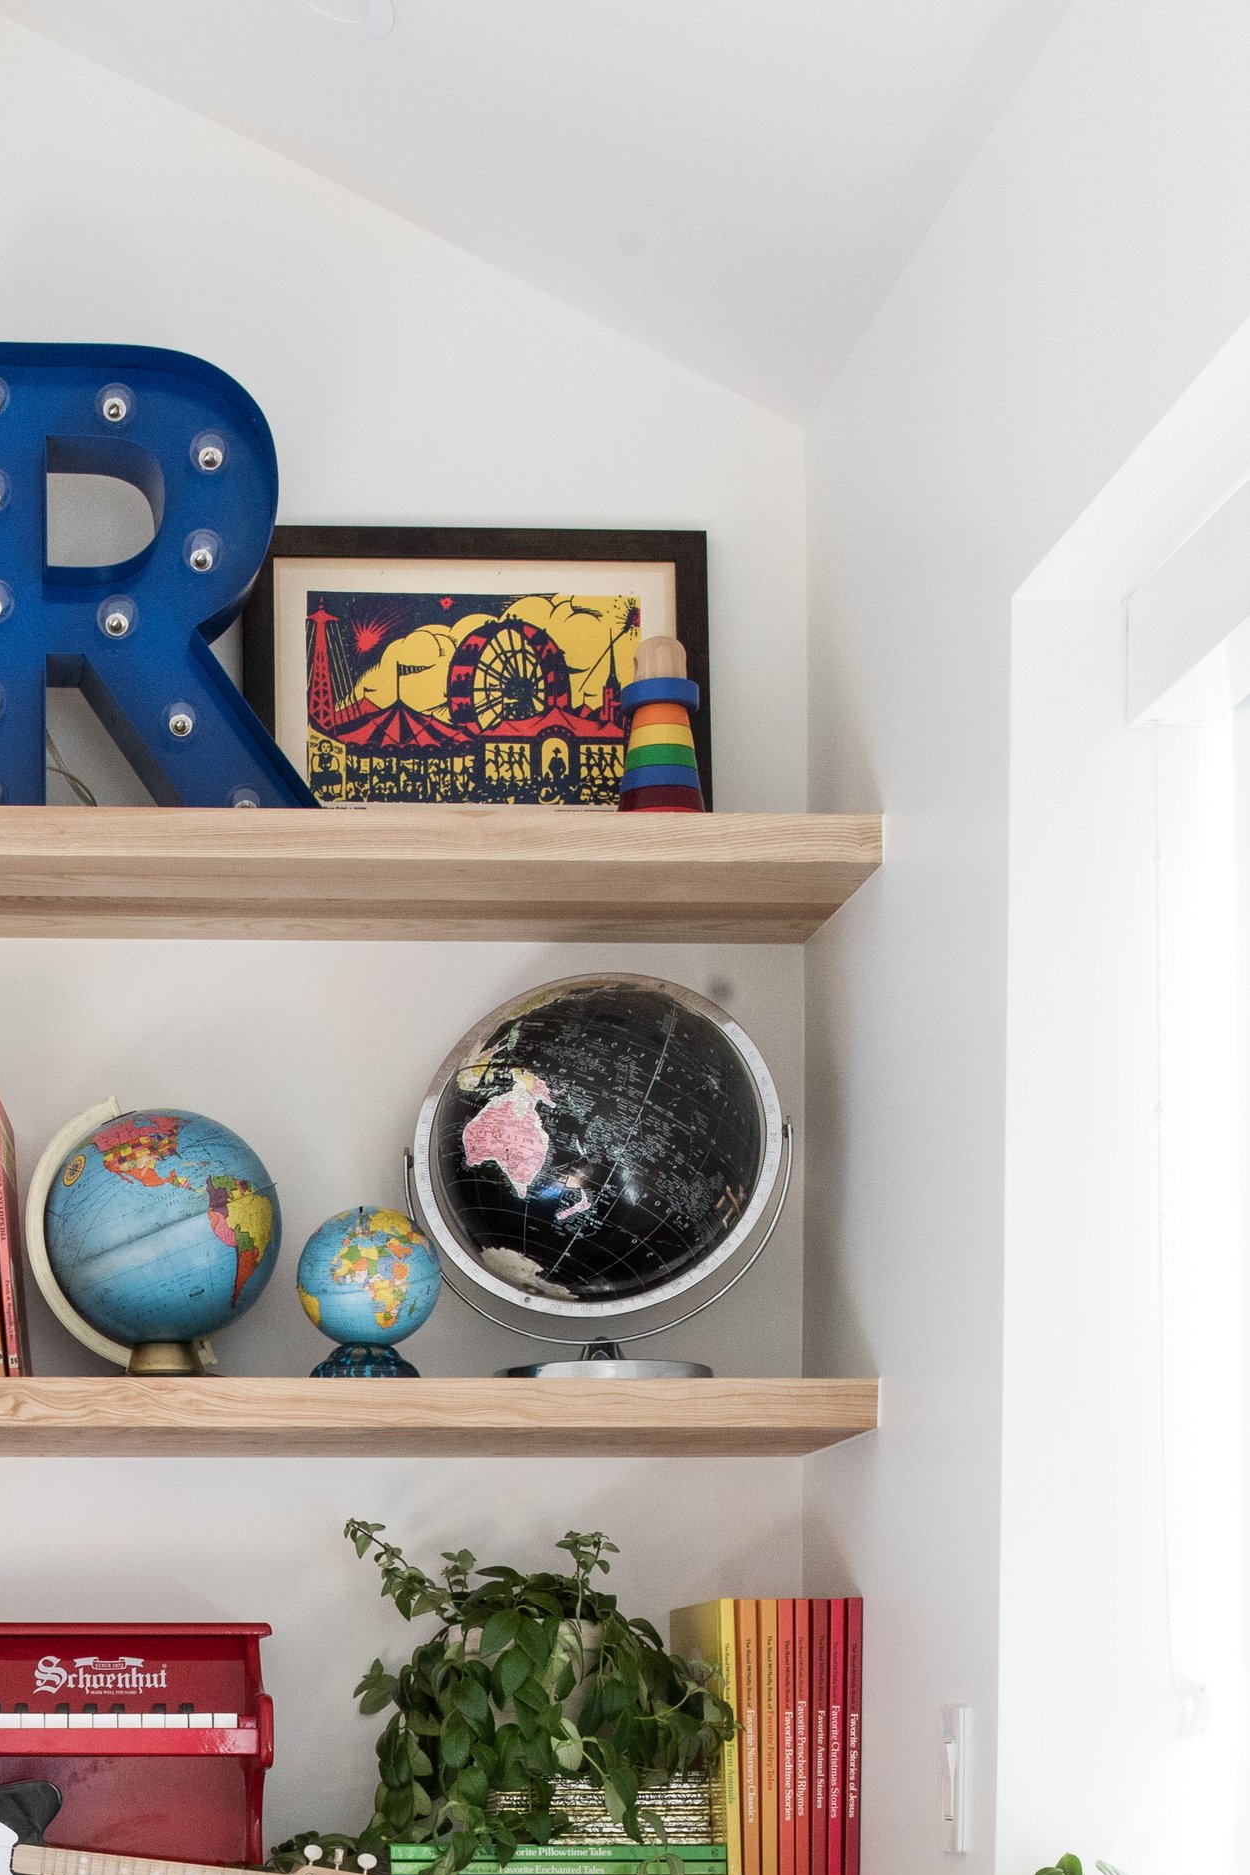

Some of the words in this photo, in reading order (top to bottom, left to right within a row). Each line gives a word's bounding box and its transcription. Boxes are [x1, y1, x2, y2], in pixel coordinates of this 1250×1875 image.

[33, 1656, 167, 1694] Schoenhut
[785, 1712, 793, 1746] Favorite
[798, 1701, 806, 1736] Favorite
[831, 1706, 840, 1741] Favorite
[850, 1714, 858, 1748] Favorite
[726, 1744, 734, 1767] Farm
[746, 1748, 755, 1784] Nursery
[766, 1747, 774, 1768] Fairy
[785, 1749, 793, 1788] Bedtime
[798, 1737, 806, 1779] Preschool
[831, 1742, 839, 1786] Christmas
[849, 1750, 858, 1780] Stories
[727, 1769, 735, 1804] Animals
[796, 1781, 806, 1816] Rhymes
[831, 1787, 839, 1818] Stories
[849, 1782, 857, 1792] of
[748, 1786, 756, 1823] Classics
[785, 1789, 793, 1821] Stories
[849, 1792, 857, 1817] Jesus
[516, 1848, 537, 1856] orite
[538, 1847, 588, 1856] Pillowtime
[589, 1848, 611, 1856] Tales
[535, 1866, 582, 1874] Enchanted
[582, 1866, 605, 1874] Tales
